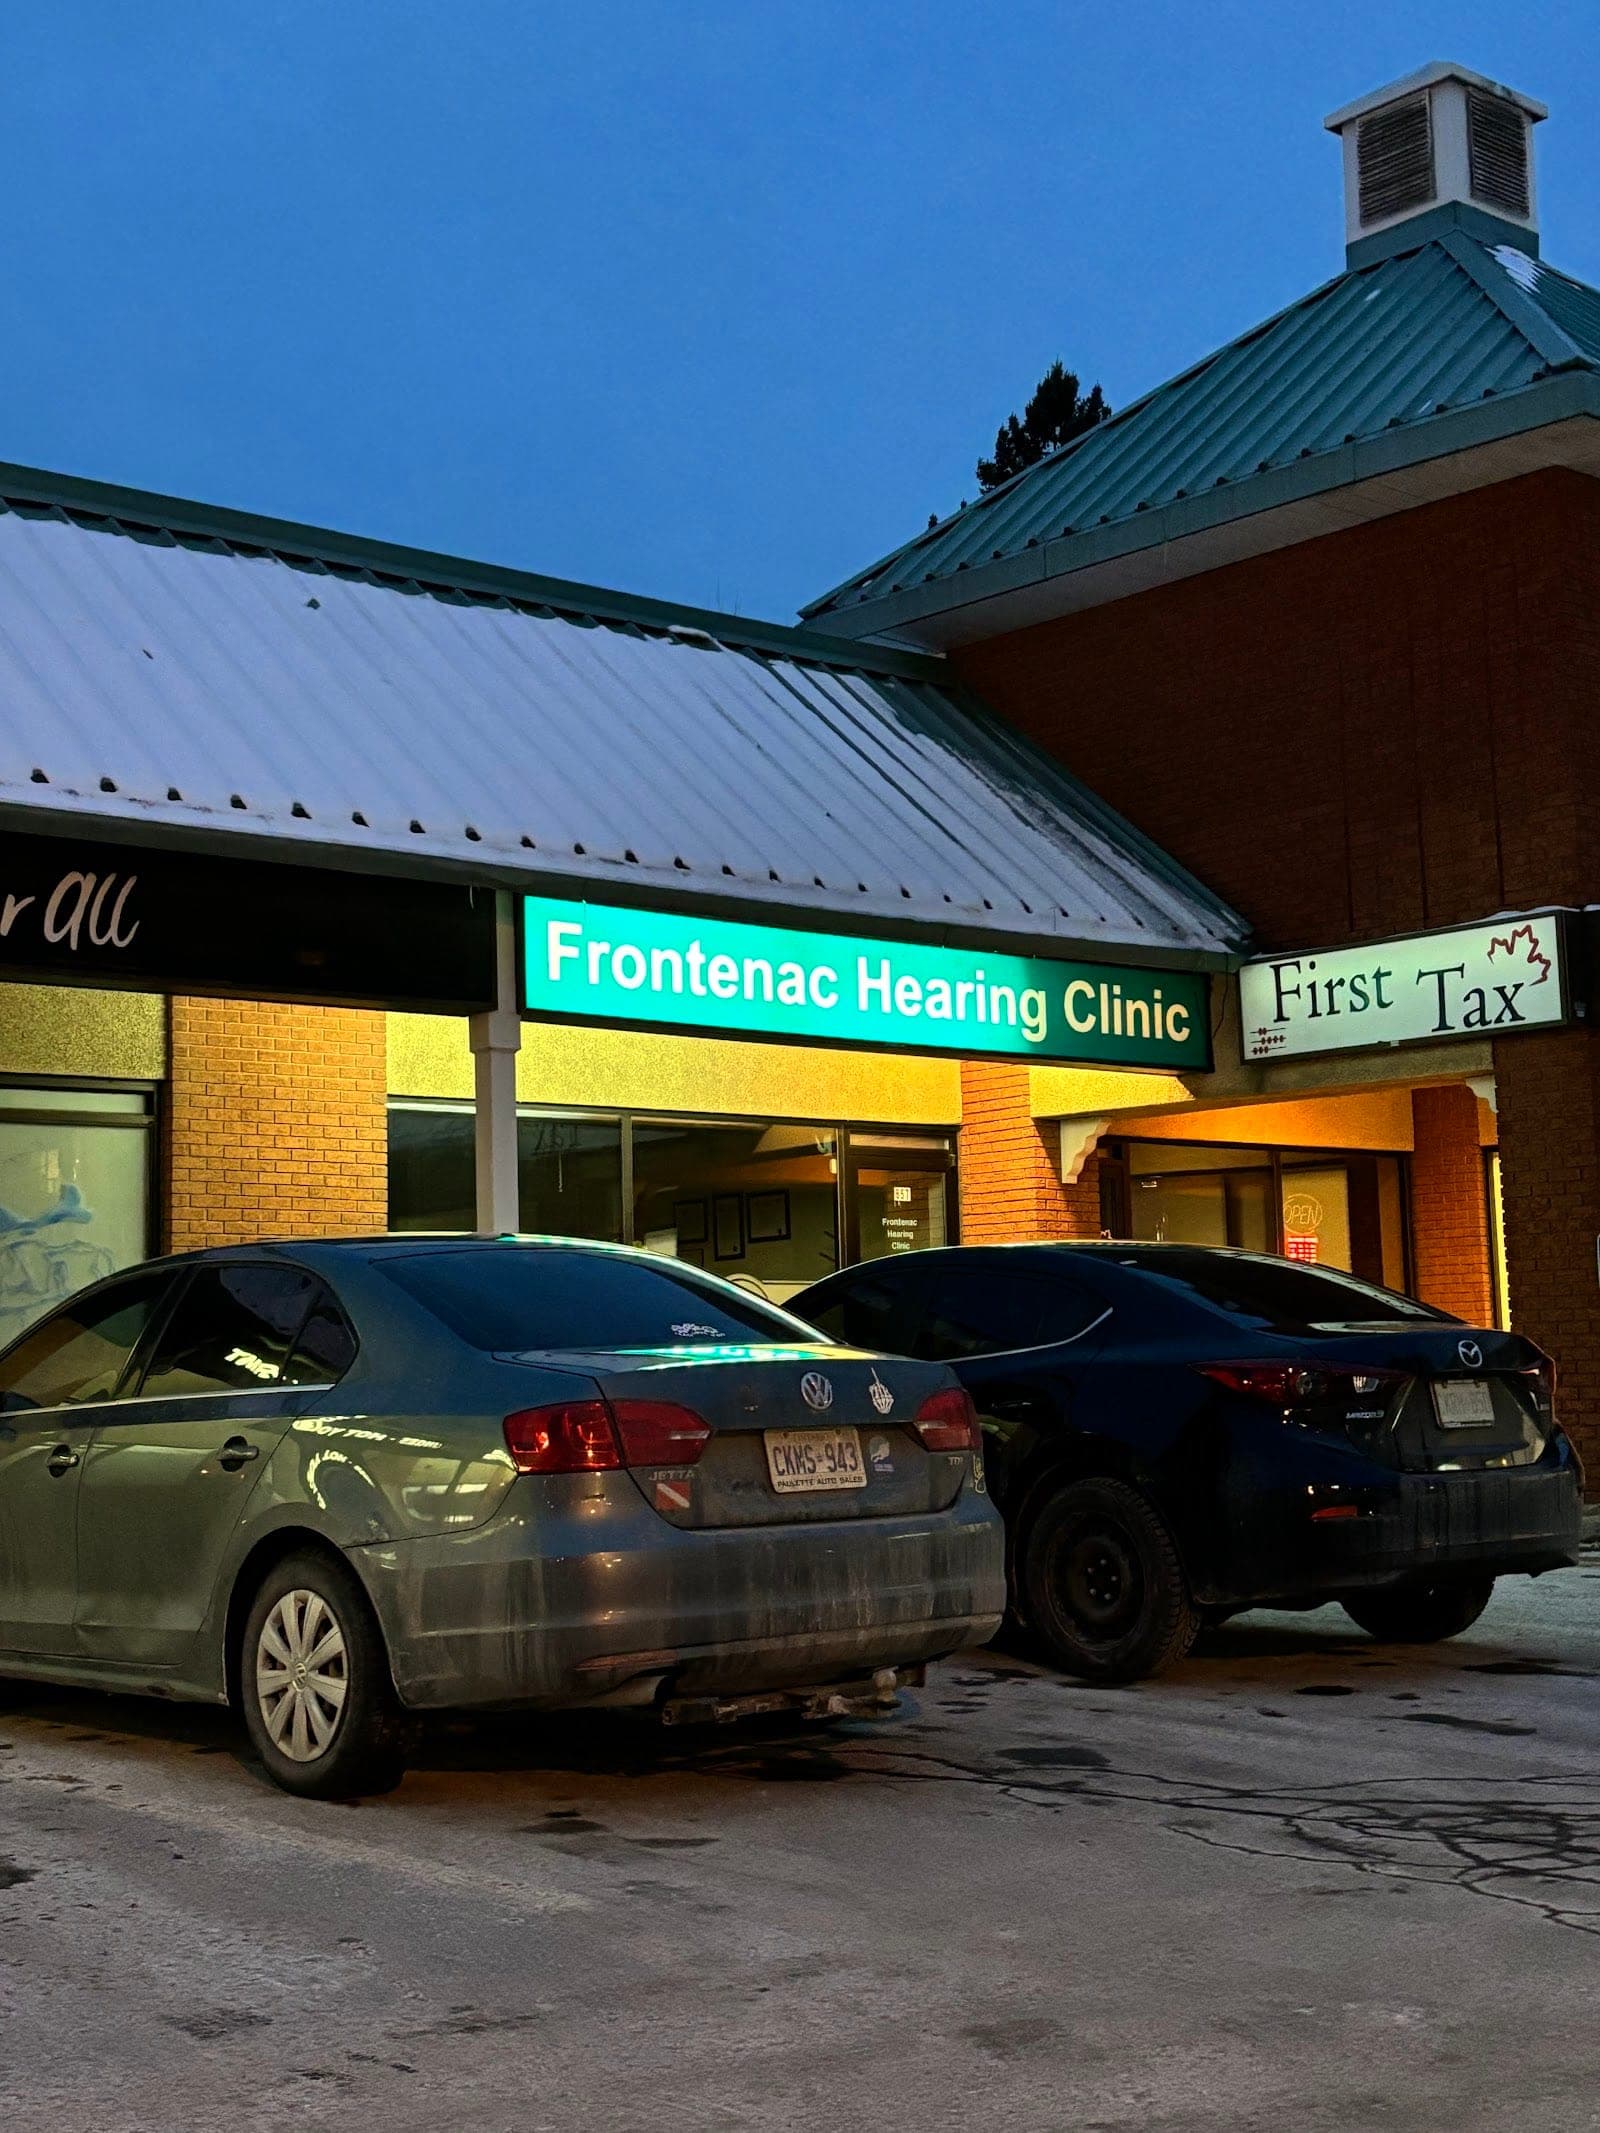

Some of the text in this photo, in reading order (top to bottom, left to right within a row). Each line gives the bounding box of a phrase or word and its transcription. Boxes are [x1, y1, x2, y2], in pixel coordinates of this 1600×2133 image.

[43, 870, 140, 951] all
[547, 920, 1190, 1042] Frontenac Hearing Clinic
[1269, 960, 1526, 1033] First Tax
[882, 1217, 918, 1227] Frontenac
[887, 1229, 914, 1240] Hearing
[891, 1241, 910, 1250] Clinic
[648, 1470, 697, 1481] JETTA
[816, 1477, 838, 1486] AUTO
[840, 1475, 864, 1485] SALES
